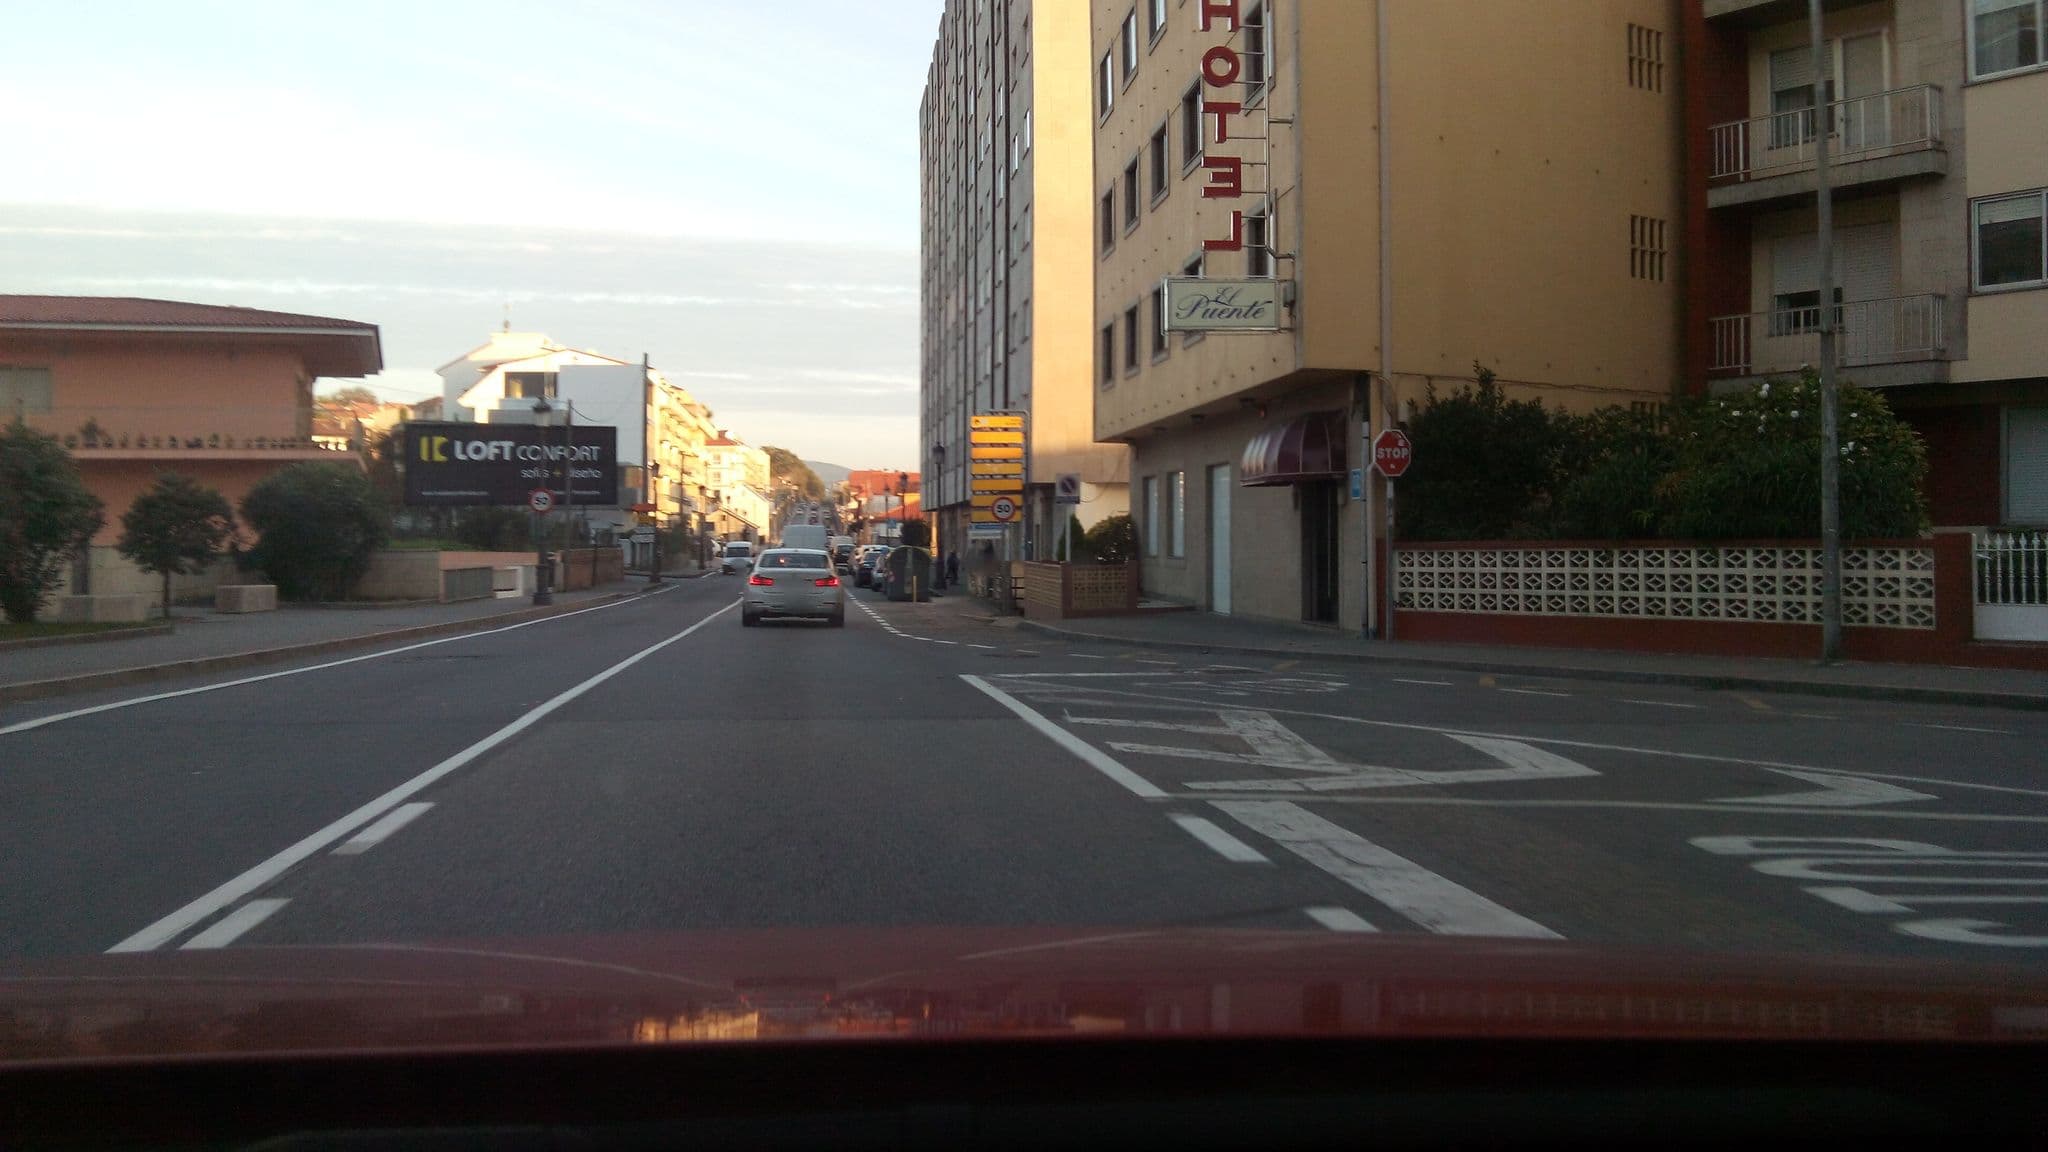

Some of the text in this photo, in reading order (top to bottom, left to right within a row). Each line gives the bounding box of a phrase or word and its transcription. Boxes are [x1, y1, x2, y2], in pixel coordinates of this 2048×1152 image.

[1210, 286, 1243, 306] El
[1175, 294, 1273, 319] Puente
[454, 440, 515, 461] LOFT
[1377, 447, 1409, 459] STOP
[535, 496, 548, 505] 50
[997, 504, 1010, 513] 50
